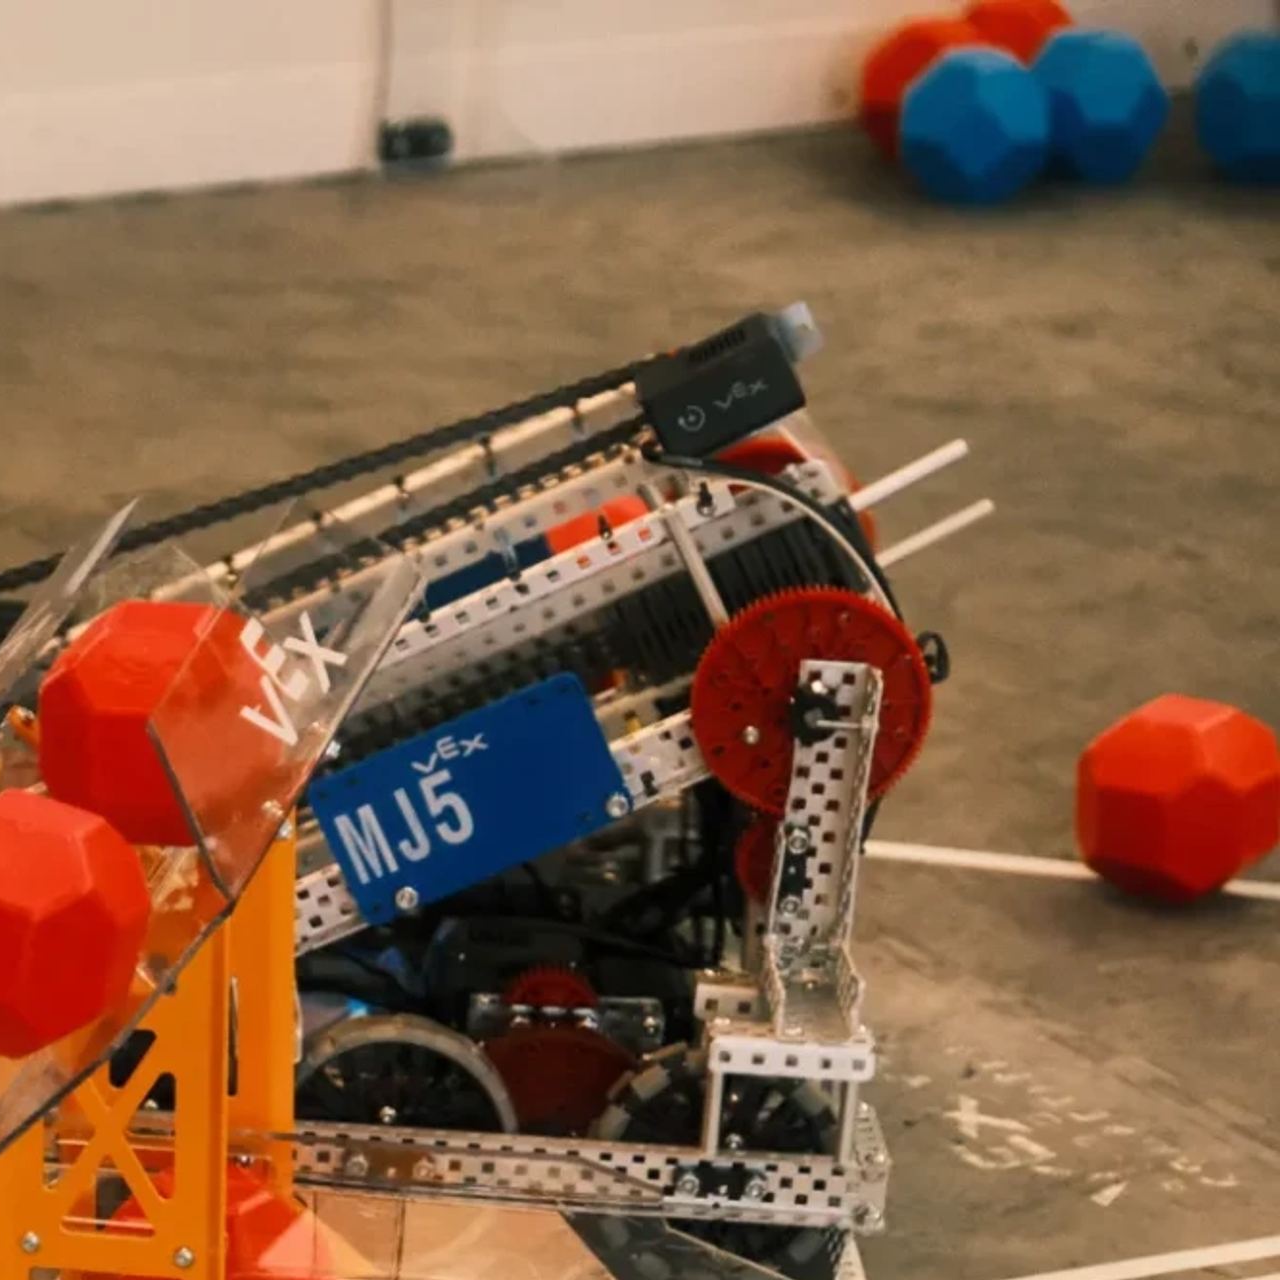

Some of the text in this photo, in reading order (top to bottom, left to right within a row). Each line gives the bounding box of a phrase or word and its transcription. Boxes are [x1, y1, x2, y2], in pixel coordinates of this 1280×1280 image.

[240, 611, 348, 746] VEX
[411, 733, 488, 773] VEX
[334, 769, 474, 885] MJ5
